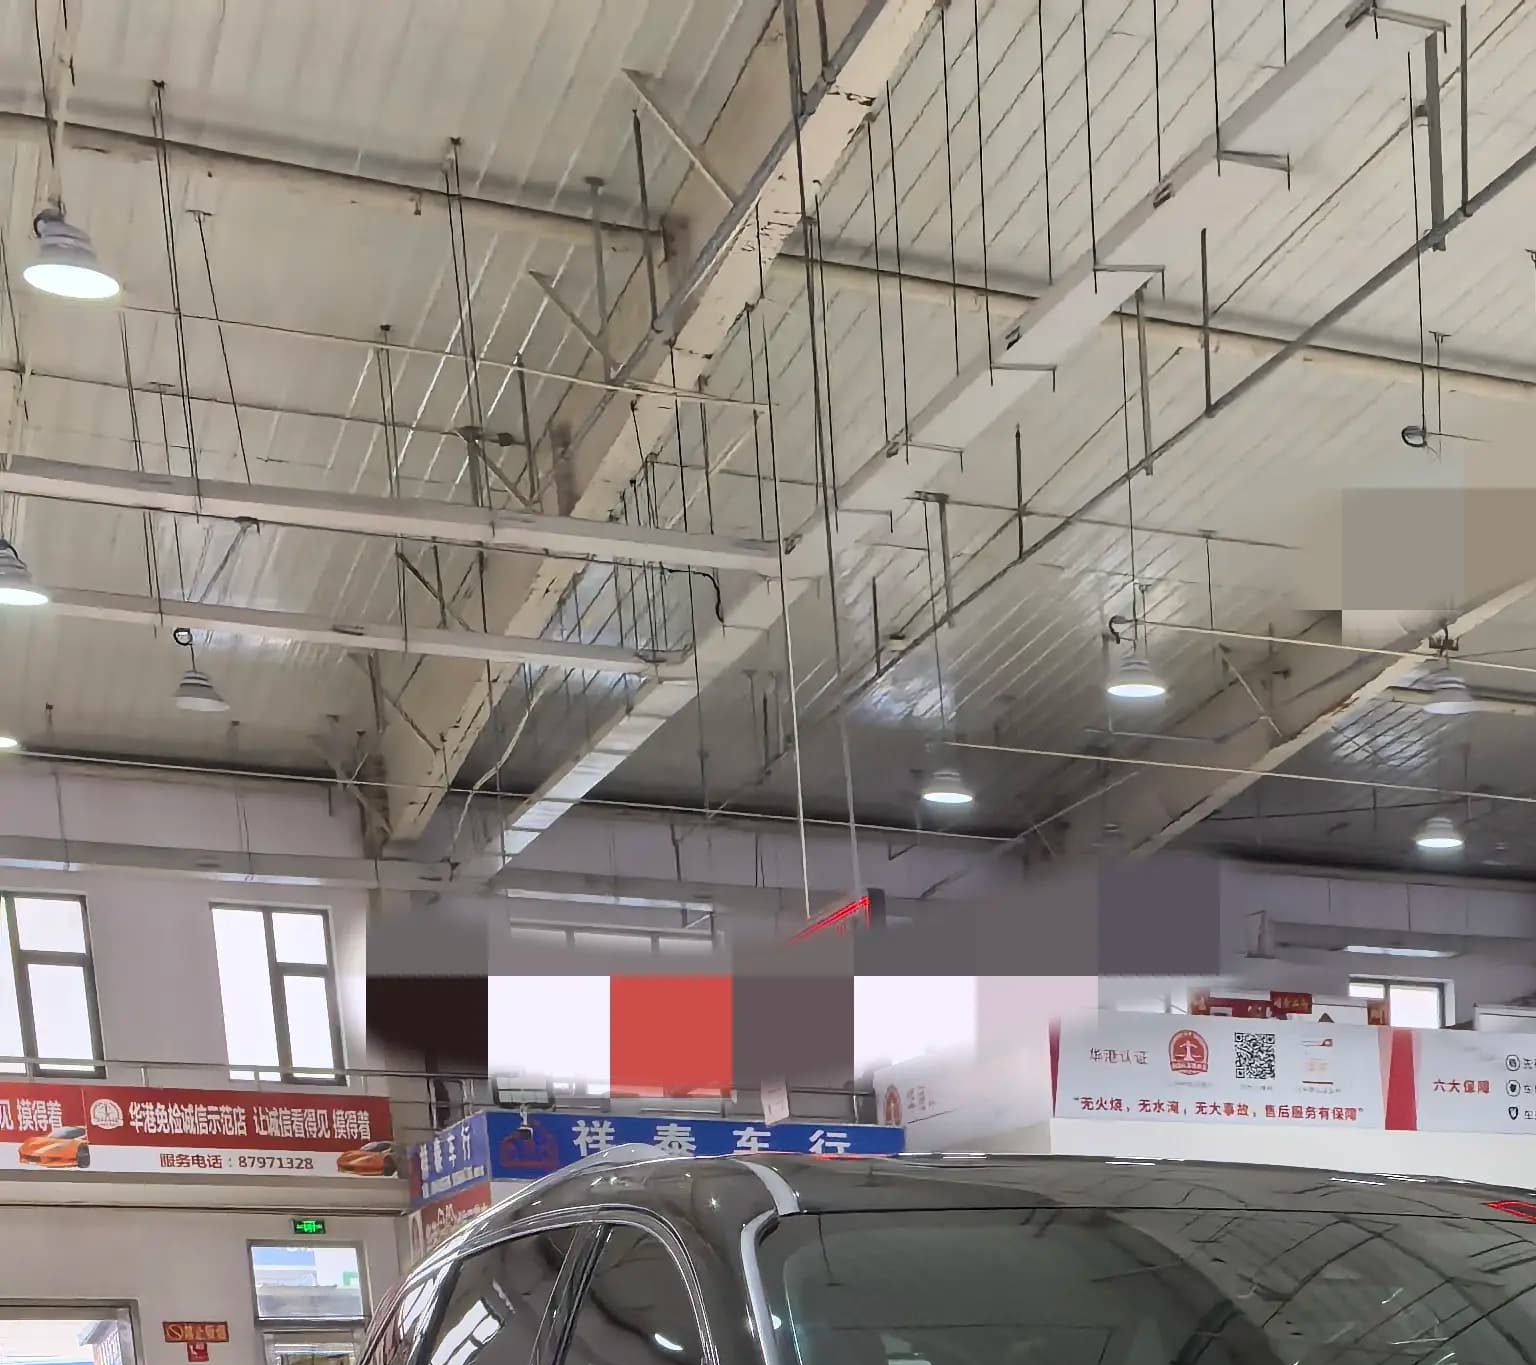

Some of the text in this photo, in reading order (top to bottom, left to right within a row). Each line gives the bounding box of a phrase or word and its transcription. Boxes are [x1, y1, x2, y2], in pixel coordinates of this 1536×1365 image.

[1433, 1079, 1490, 1094] 六大保障
[17, 1098, 62, 1137] 摸得着
[129, 1101, 370, 1141] 华港免检诚信示范店 让诚信看得见 摸得着
[572, 1119, 852, 1157] 祥泰车行
